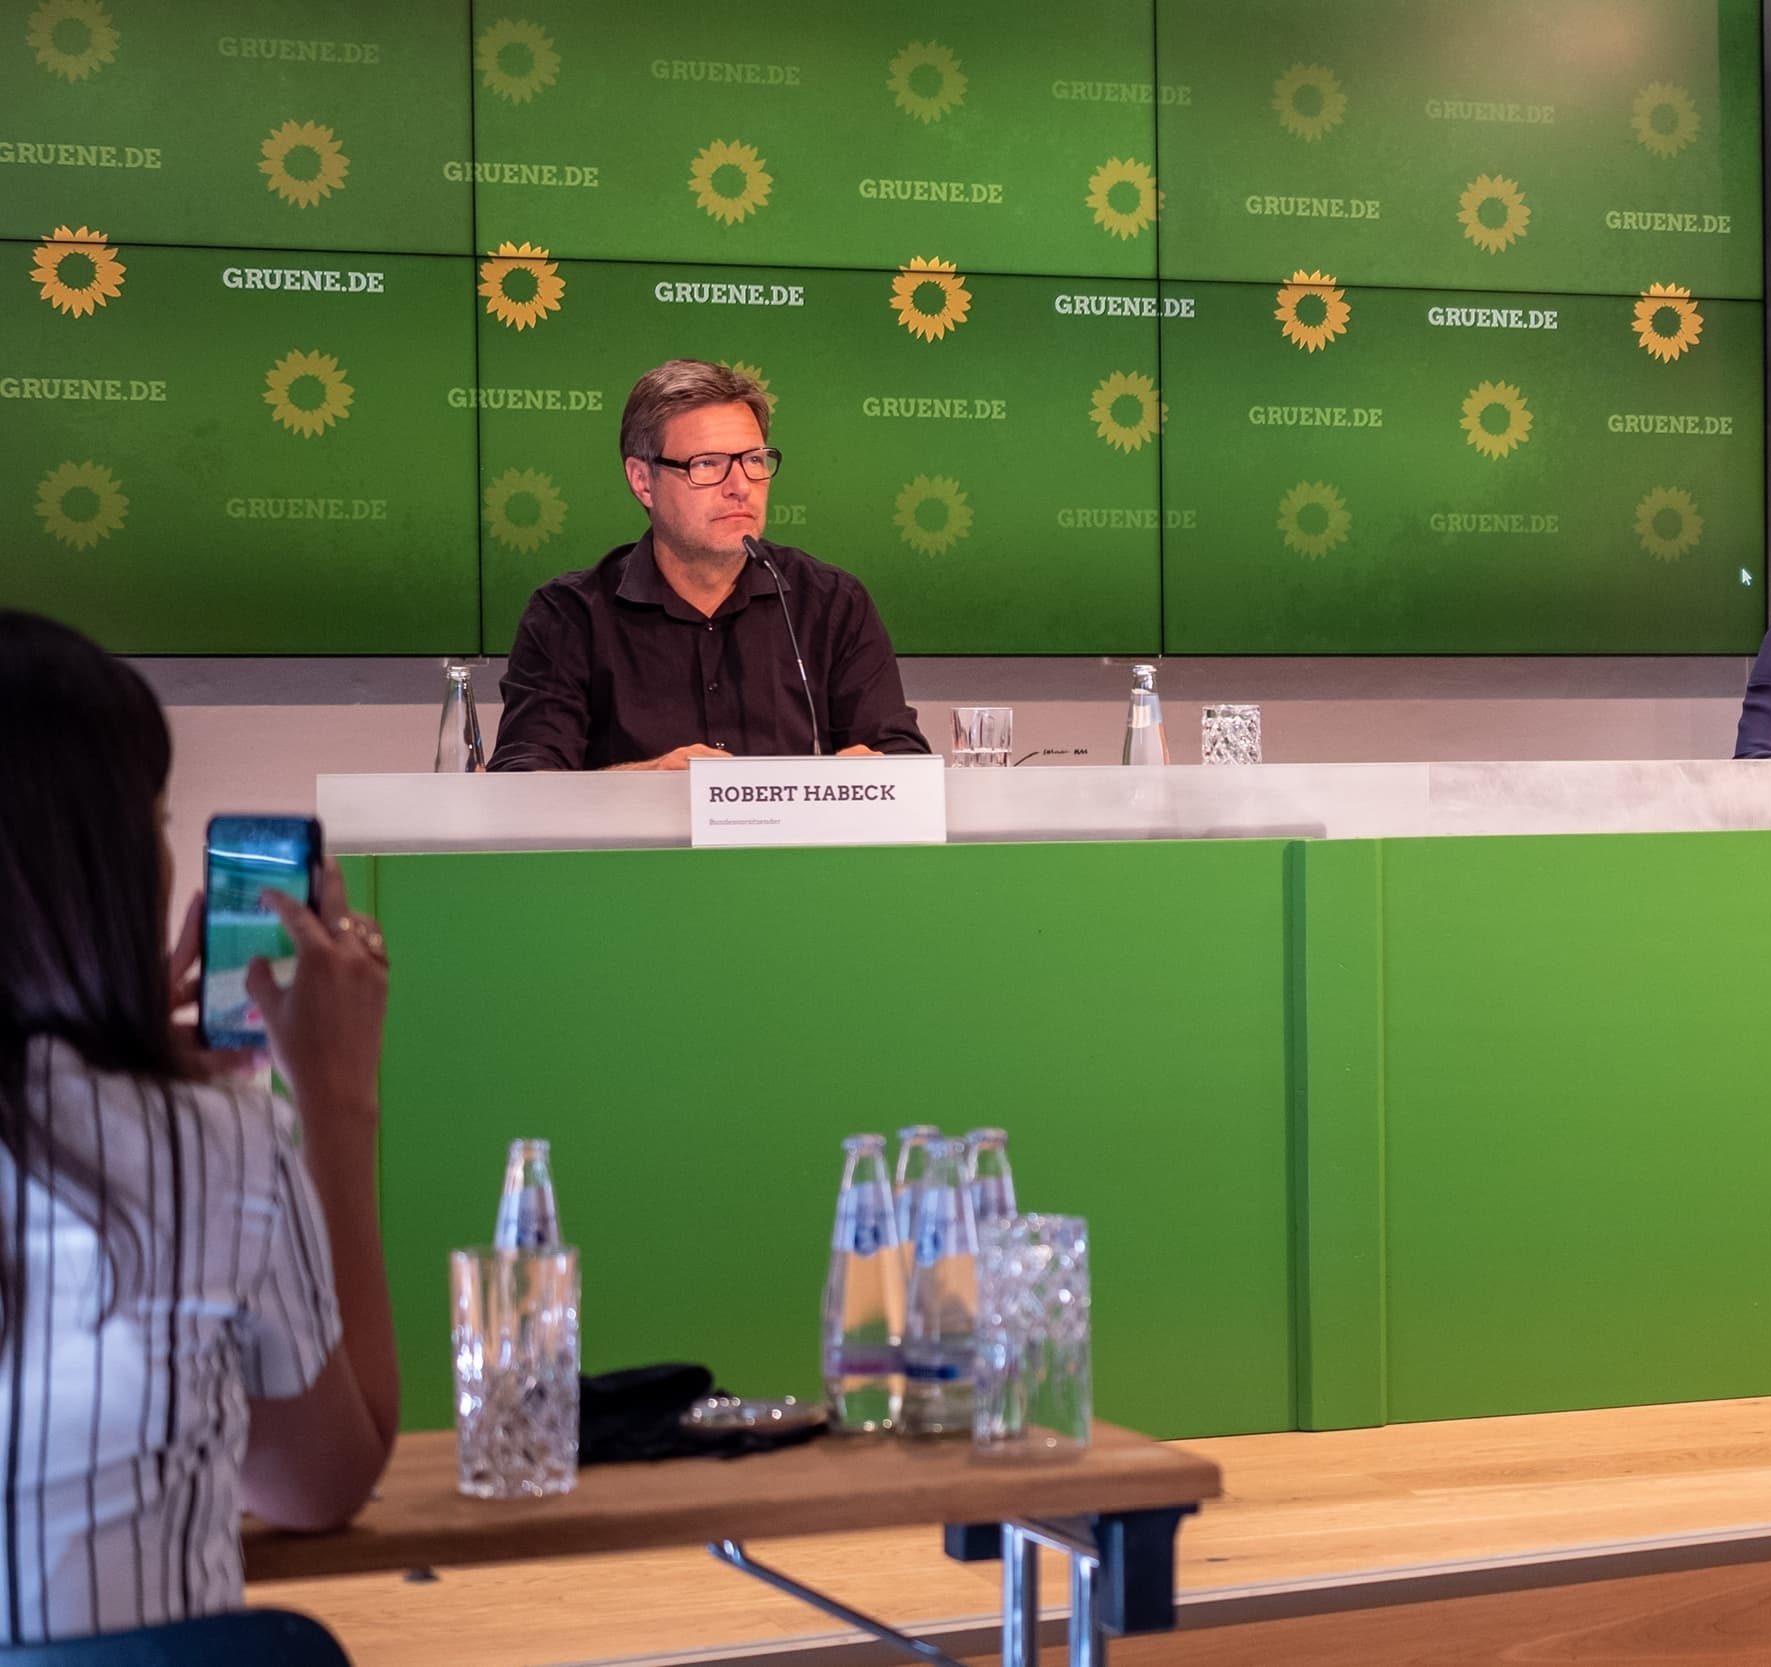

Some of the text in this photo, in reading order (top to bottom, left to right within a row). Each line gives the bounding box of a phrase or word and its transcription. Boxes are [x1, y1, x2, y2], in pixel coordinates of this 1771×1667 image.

[219, 37, 380, 65] GRUENE.DE
[651, 60, 800, 86] GRUENE.DE
[1051, 80, 1192, 106] GRUENEDE
[1426, 100, 1555, 125] GRUENE.DE
[0, 142, 161, 168] GRUENE.DE
[444, 162, 599, 188] GRUENE.DE
[859, 179, 1003, 204] GRUENE.DE
[1246, 195, 1380, 220] GRUENE.DE
[1606, 211, 1731, 235] GRUENE.DE
[222, 268, 385, 293] GRUENE.DE
[655, 282, 804, 307] GRUENE.DE
[1055, 295, 1195, 320] GRUENE.DE
[1428, 307, 1558, 331] GRUENE.DE
[0, 378, 167, 401] GRUENE.DE
[448, 388, 603, 412] GRUENE.DE
[863, 396, 1006, 421] GRUENE.DE
[1249, 405, 1383, 429] GRUENE.DE
[1608, 414, 1733, 437] GRUENE.DE
[226, 499, 388, 522] GRUENE.DE
[1057, 508, 1197, 530] GRUENEDE
[1430, 513, 1559, 535] GRUENE.DE
[709, 785, 896, 802] ROBERT HABECK
